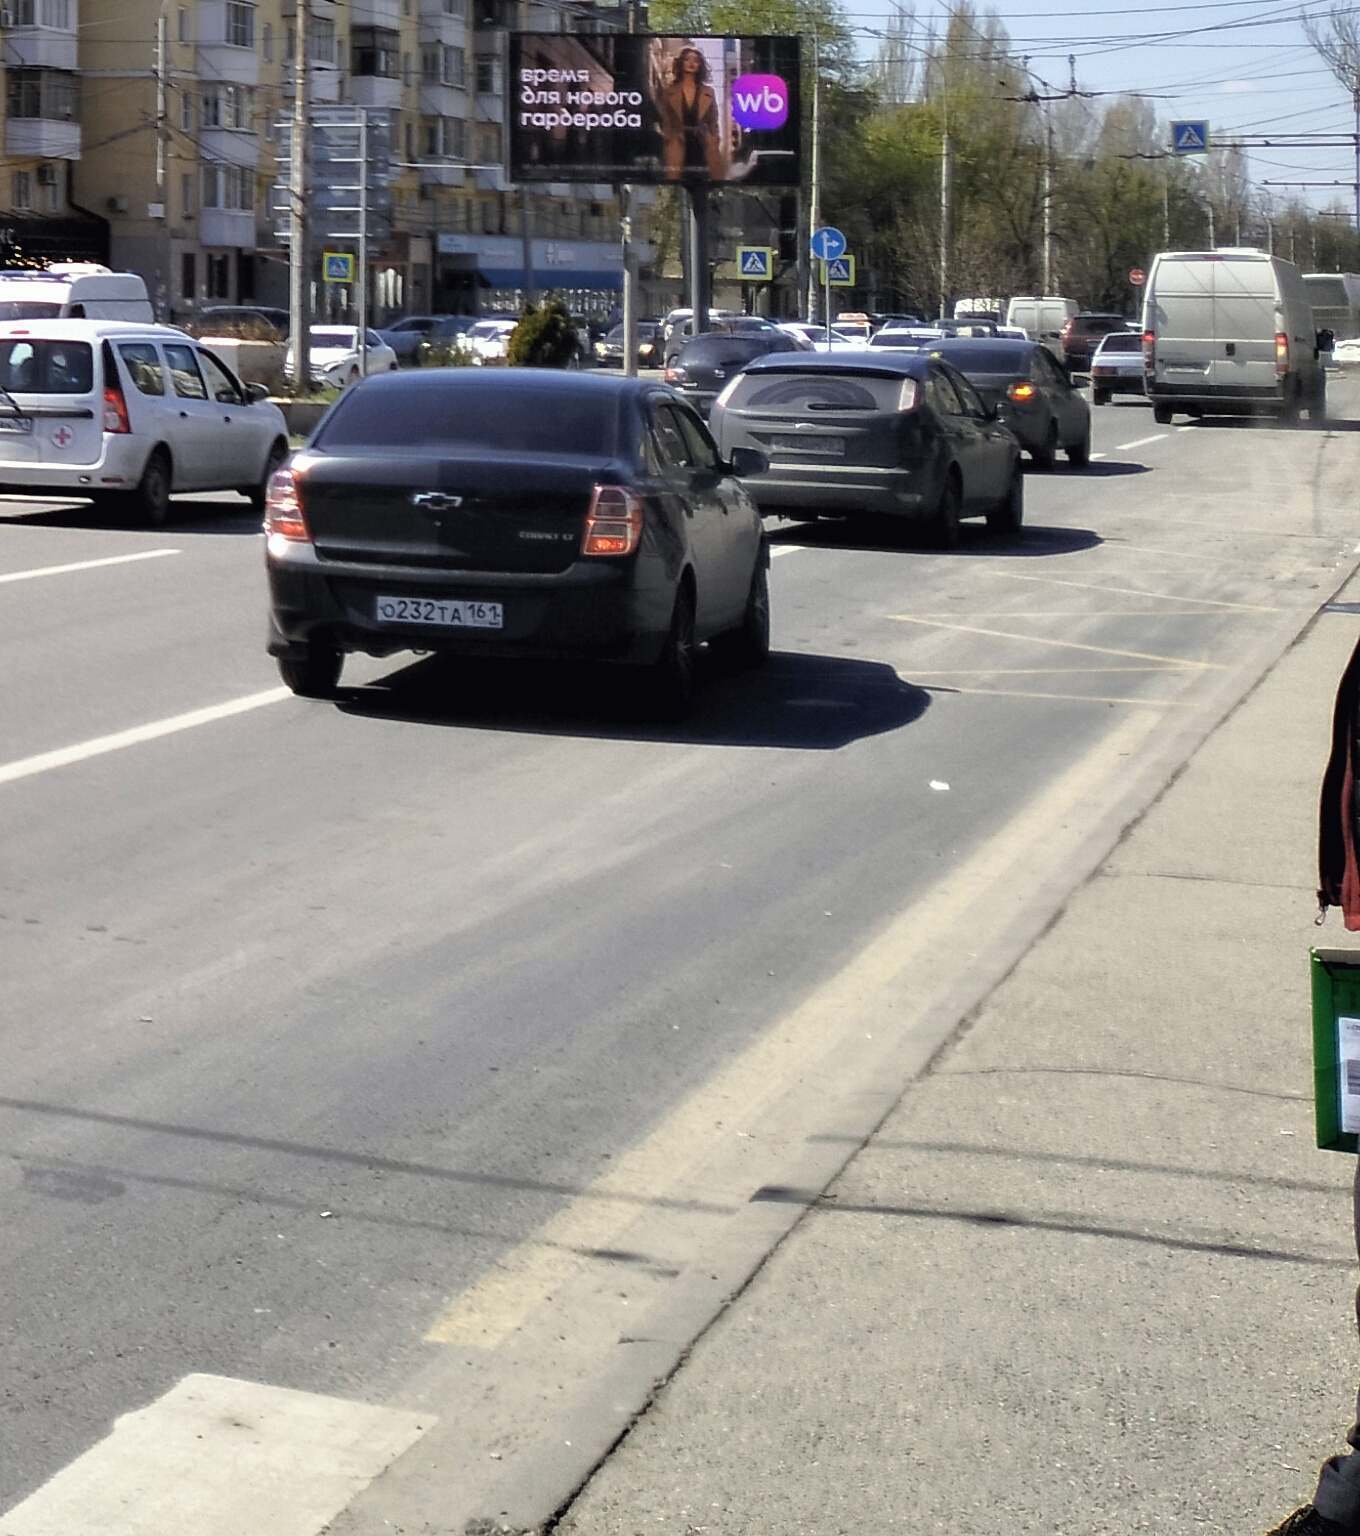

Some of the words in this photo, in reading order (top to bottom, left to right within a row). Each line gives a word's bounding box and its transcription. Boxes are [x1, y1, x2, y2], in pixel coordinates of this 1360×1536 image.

[520, 68, 590, 87] время
[520, 86, 561, 106] для
[566, 91, 643, 107] нового
[735, 85, 784, 114] wb
[520, 108, 642, 132] гардероба
[467, 603, 500, 622] 161
